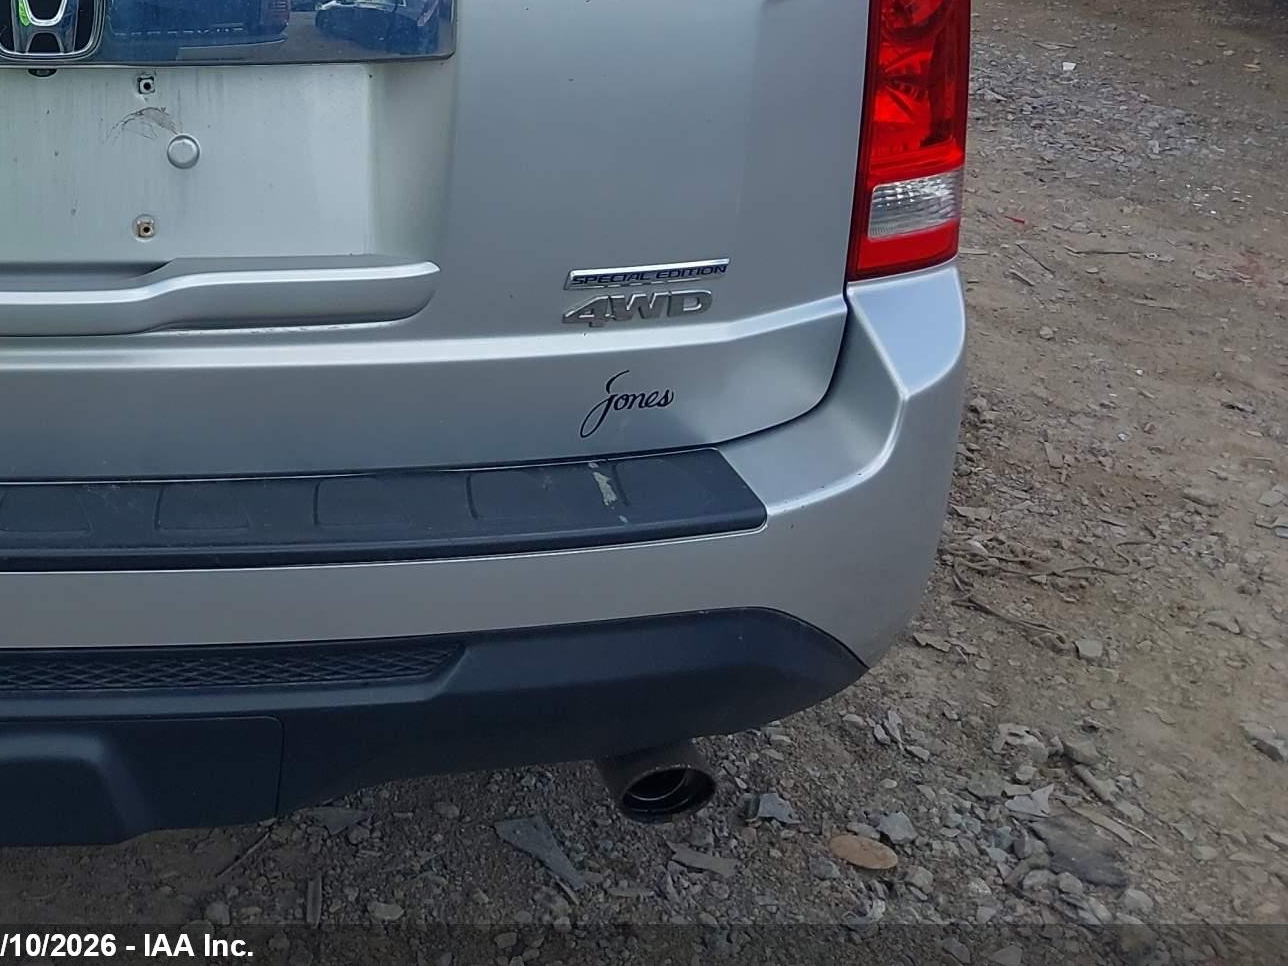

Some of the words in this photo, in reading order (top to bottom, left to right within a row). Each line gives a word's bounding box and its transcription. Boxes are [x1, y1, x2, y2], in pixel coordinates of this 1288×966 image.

[572, 272, 651, 285] SPECIAL
[655, 264, 728, 280] EDITION
[562, 289, 714, 328] 4WD
[579, 369, 675, 439] Jones
